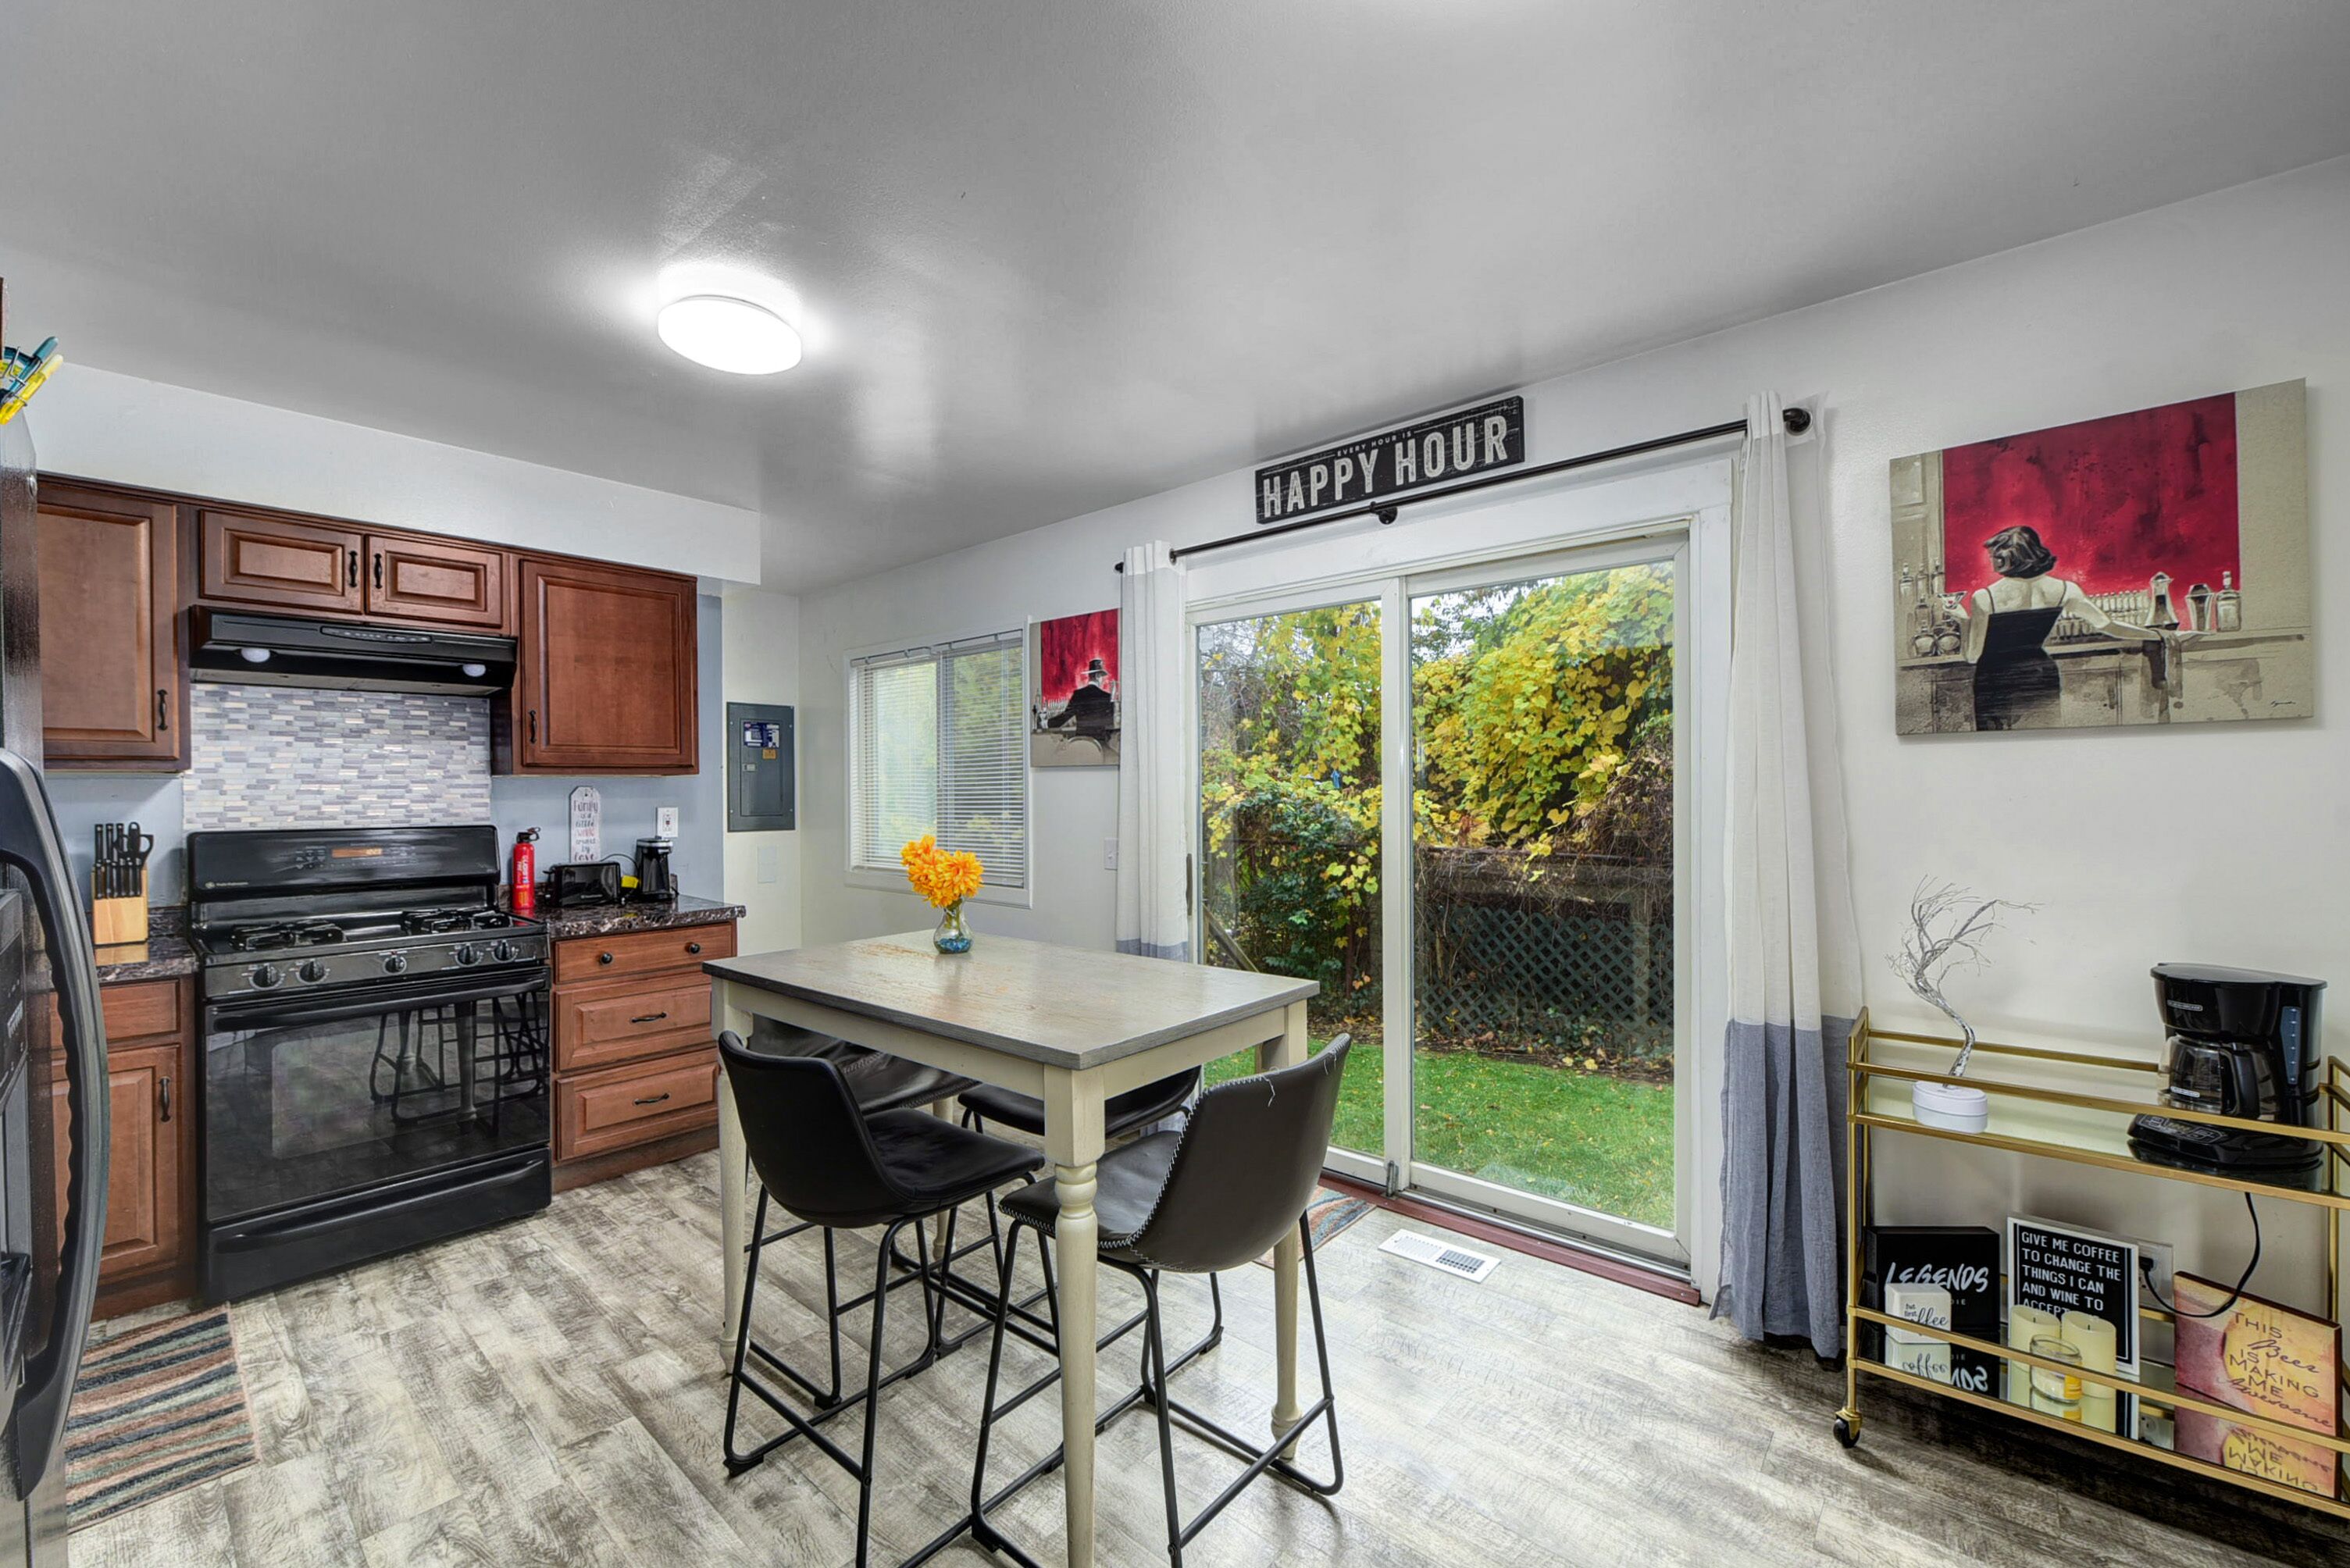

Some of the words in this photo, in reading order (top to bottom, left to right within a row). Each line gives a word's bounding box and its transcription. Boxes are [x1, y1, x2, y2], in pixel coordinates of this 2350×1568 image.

[1337, 444, 1366, 457] EVERY
[1371, 435, 1396, 447] HOUR
[1403, 430, 1411, 439] IS
[1263, 449, 1379, 519] HAPPY
[1394, 415, 1509, 486] HOUR
[2021, 1231, 2048, 1247] GIVE
[2052, 1238, 2069, 1253] ME
[2074, 1243, 2120, 1263] COFFEE
[1884, 1262, 1988, 1292] LEGENDS
[2022, 1248, 2040, 1262] TO
[2044, 1253, 2091, 1274] CHANGE
[2096, 1265, 2121, 1281] THE
[2022, 1264, 2067, 1285] THINGS
[2070, 1275, 2074, 1288] I
[2078, 1278, 2104, 1295] CAN
[2022, 1281, 2045, 1297] AND
[2050, 1288, 2080, 1306] WINE
[2084, 1296, 2104, 1311] TO
[1911, 1307, 1949, 1326] ffee
[2234, 1312, 2282, 1338] THIS
[2241, 1349, 2259, 1363] IS
[2247, 1339, 2320, 1374] Beer
[2230, 1354, 2319, 1399] MAKING
[2248, 1376, 2284, 1399] ME
[2224, 1377, 2334, 1428] Awesome
